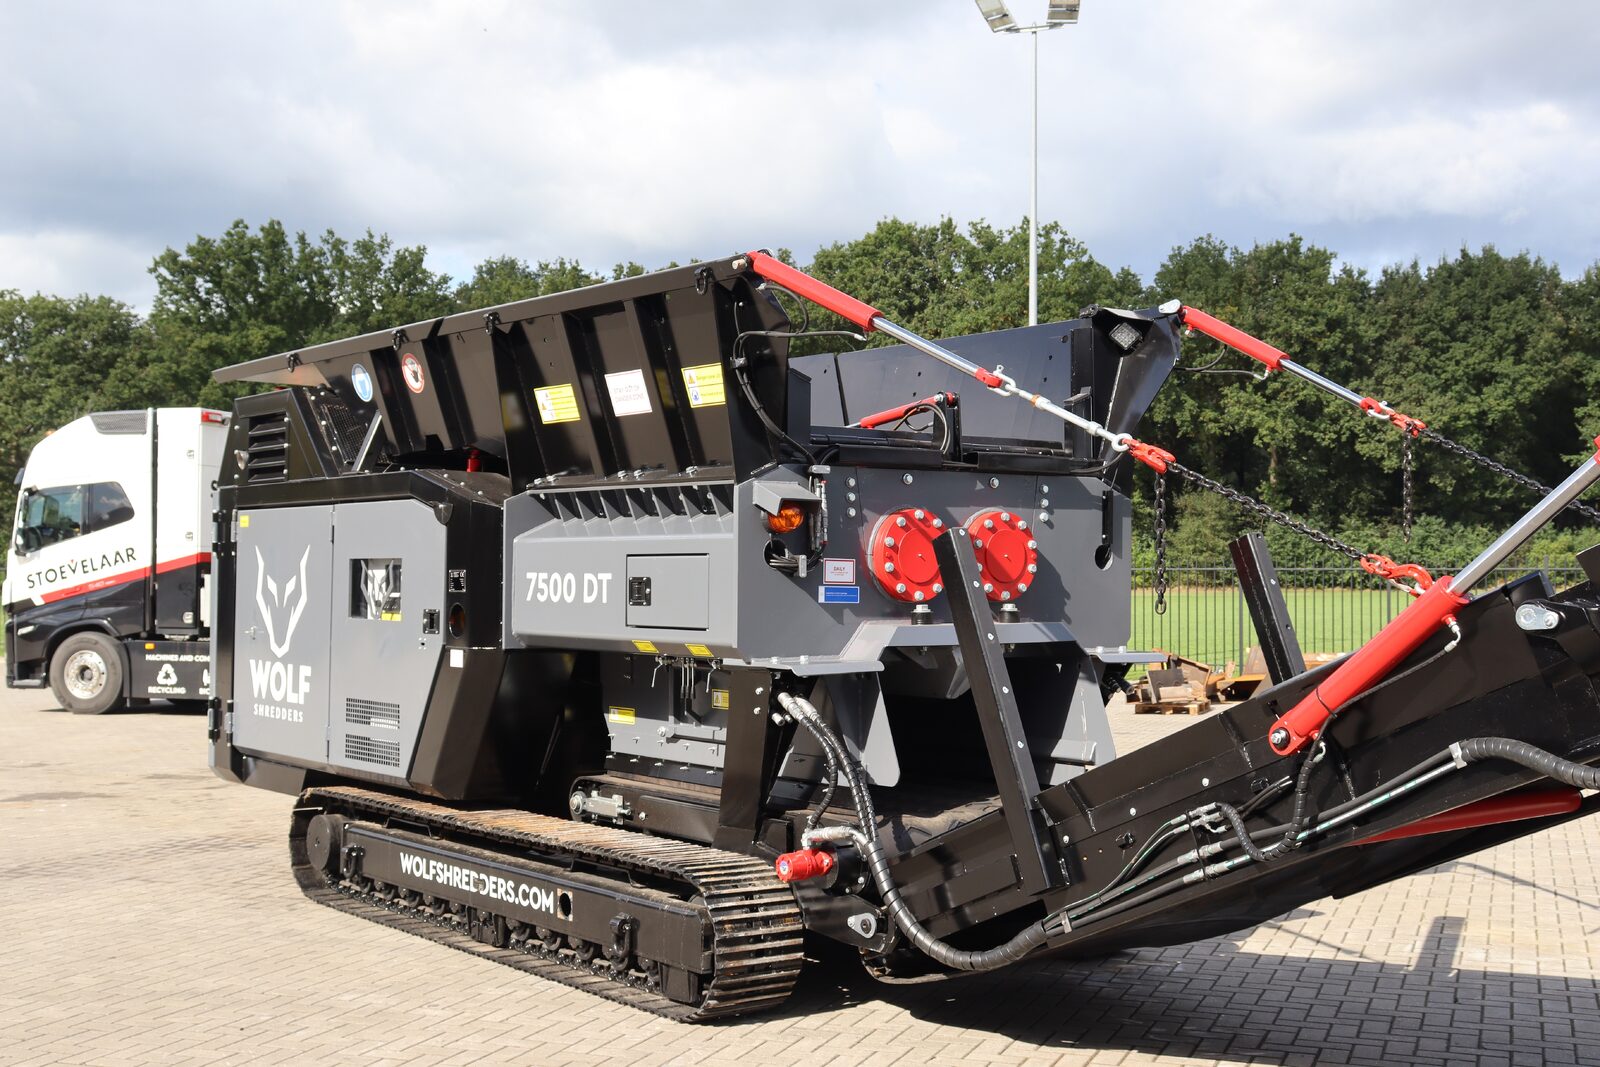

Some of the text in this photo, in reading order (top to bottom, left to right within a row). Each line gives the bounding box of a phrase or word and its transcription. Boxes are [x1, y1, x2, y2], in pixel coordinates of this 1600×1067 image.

[27, 547, 136, 589] STOEVELAAR
[526, 572, 612, 604] 7500 DT
[179, 654, 194, 662] AND
[147, 686, 187, 695] RECYCLING
[250, 659, 311, 705] WOLF
[253, 703, 304, 723] SHREDDERS
[400, 852, 554, 914] WOLFSHREDDERS.COM
